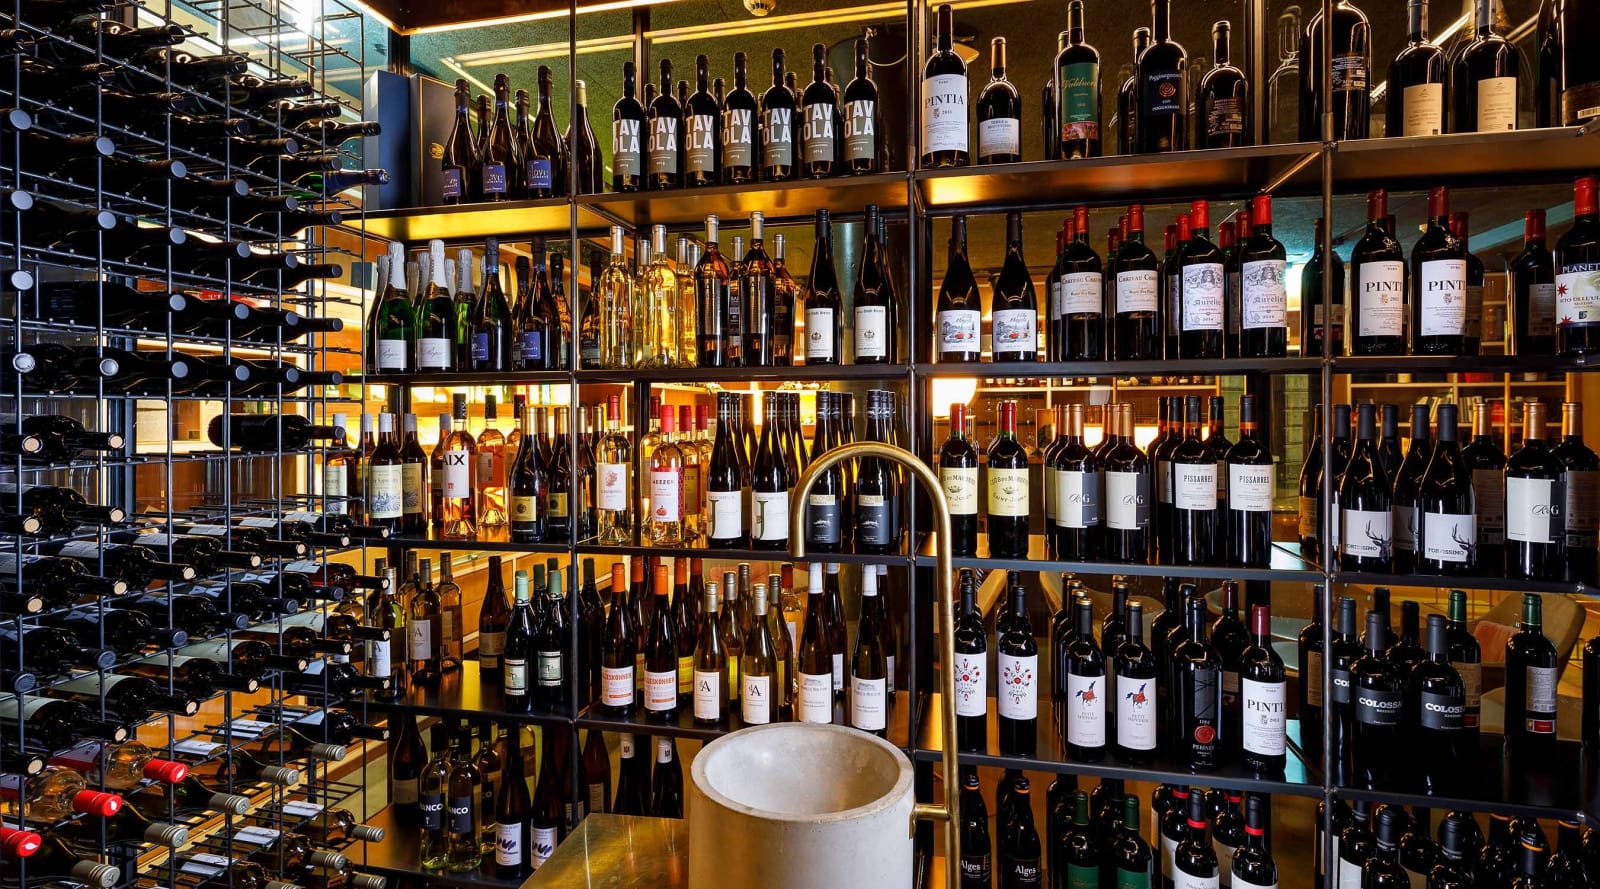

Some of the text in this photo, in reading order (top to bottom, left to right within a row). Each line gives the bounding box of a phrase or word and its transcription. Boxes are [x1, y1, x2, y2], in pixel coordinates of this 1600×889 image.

[845, 100, 874, 119] TAV
[926, 93, 964, 108] PINTIA
[724, 109, 751, 127] TAV
[763, 108, 791, 127] TAV
[804, 103, 833, 121] TAV
[685, 115, 714, 133] TAV
[804, 119, 833, 140] OLA
[845, 116, 874, 138] OLA
[685, 132, 714, 152] OLA
[724, 125, 751, 145] OLA
[763, 125, 791, 145] OLA
[443, 454, 465, 466] AIX
[1428, 547, 1465, 556] FORISSIMO
[961, 859, 981, 873] Alges
[1015, 865, 1037, 877] Alges
